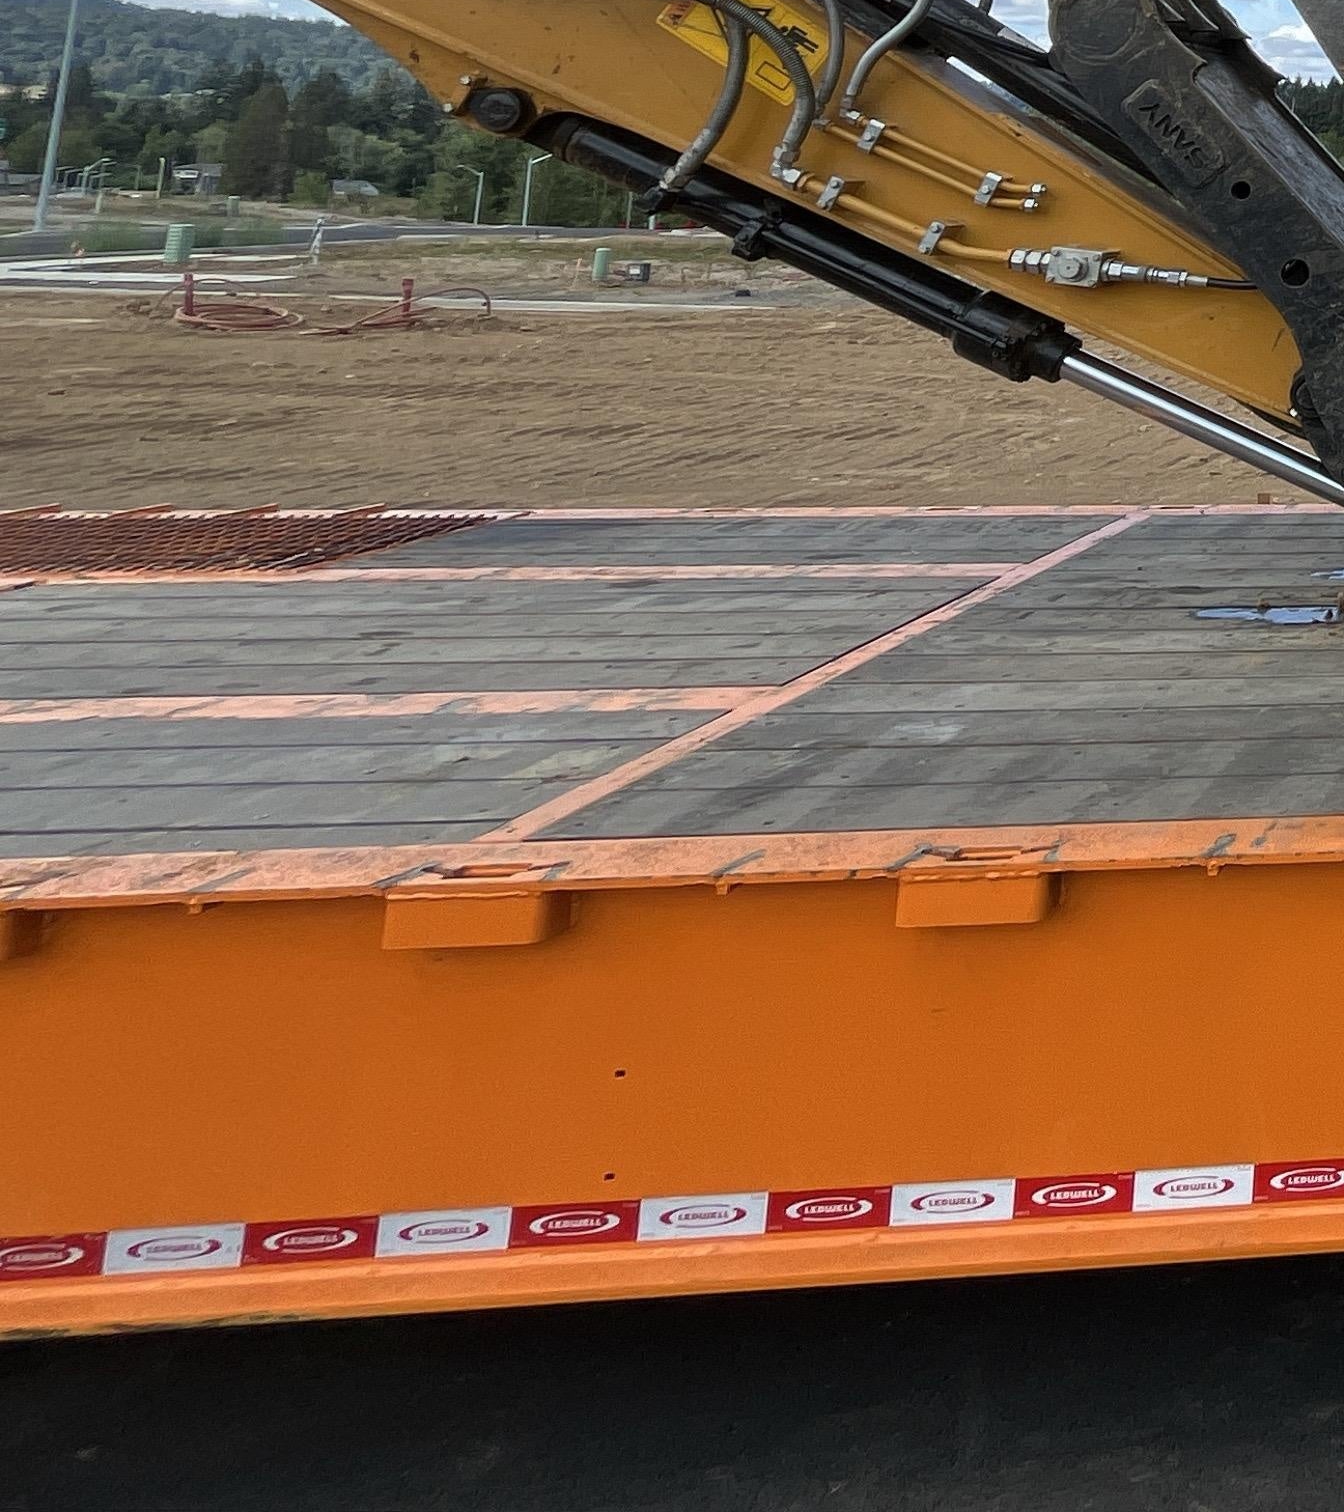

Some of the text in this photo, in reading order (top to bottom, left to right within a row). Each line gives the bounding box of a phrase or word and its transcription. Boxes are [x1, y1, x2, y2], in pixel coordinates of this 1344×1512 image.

[1287, 1171, 1336, 1186] LEDWELL
[1049, 1186, 1100, 1200] LEDWELL
[1170, 1179, 1219, 1193] LEDWELL
[927, 1195, 979, 1207] LEDWELL
